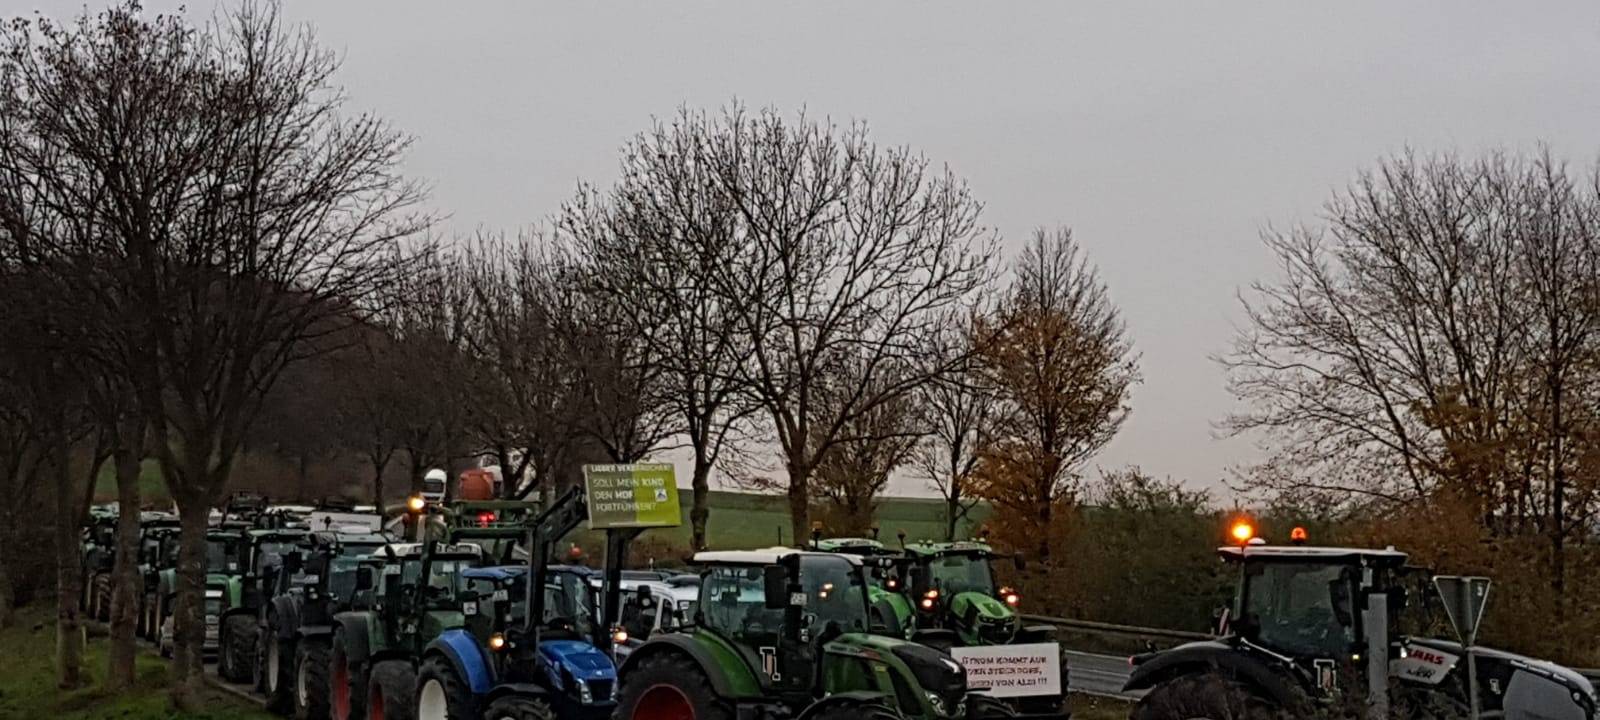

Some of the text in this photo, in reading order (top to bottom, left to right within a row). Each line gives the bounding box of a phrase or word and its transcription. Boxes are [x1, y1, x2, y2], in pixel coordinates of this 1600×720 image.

[593, 478, 613, 487] SOLL
[616, 478, 640, 487] MEIN
[594, 490, 613, 500] DEN
